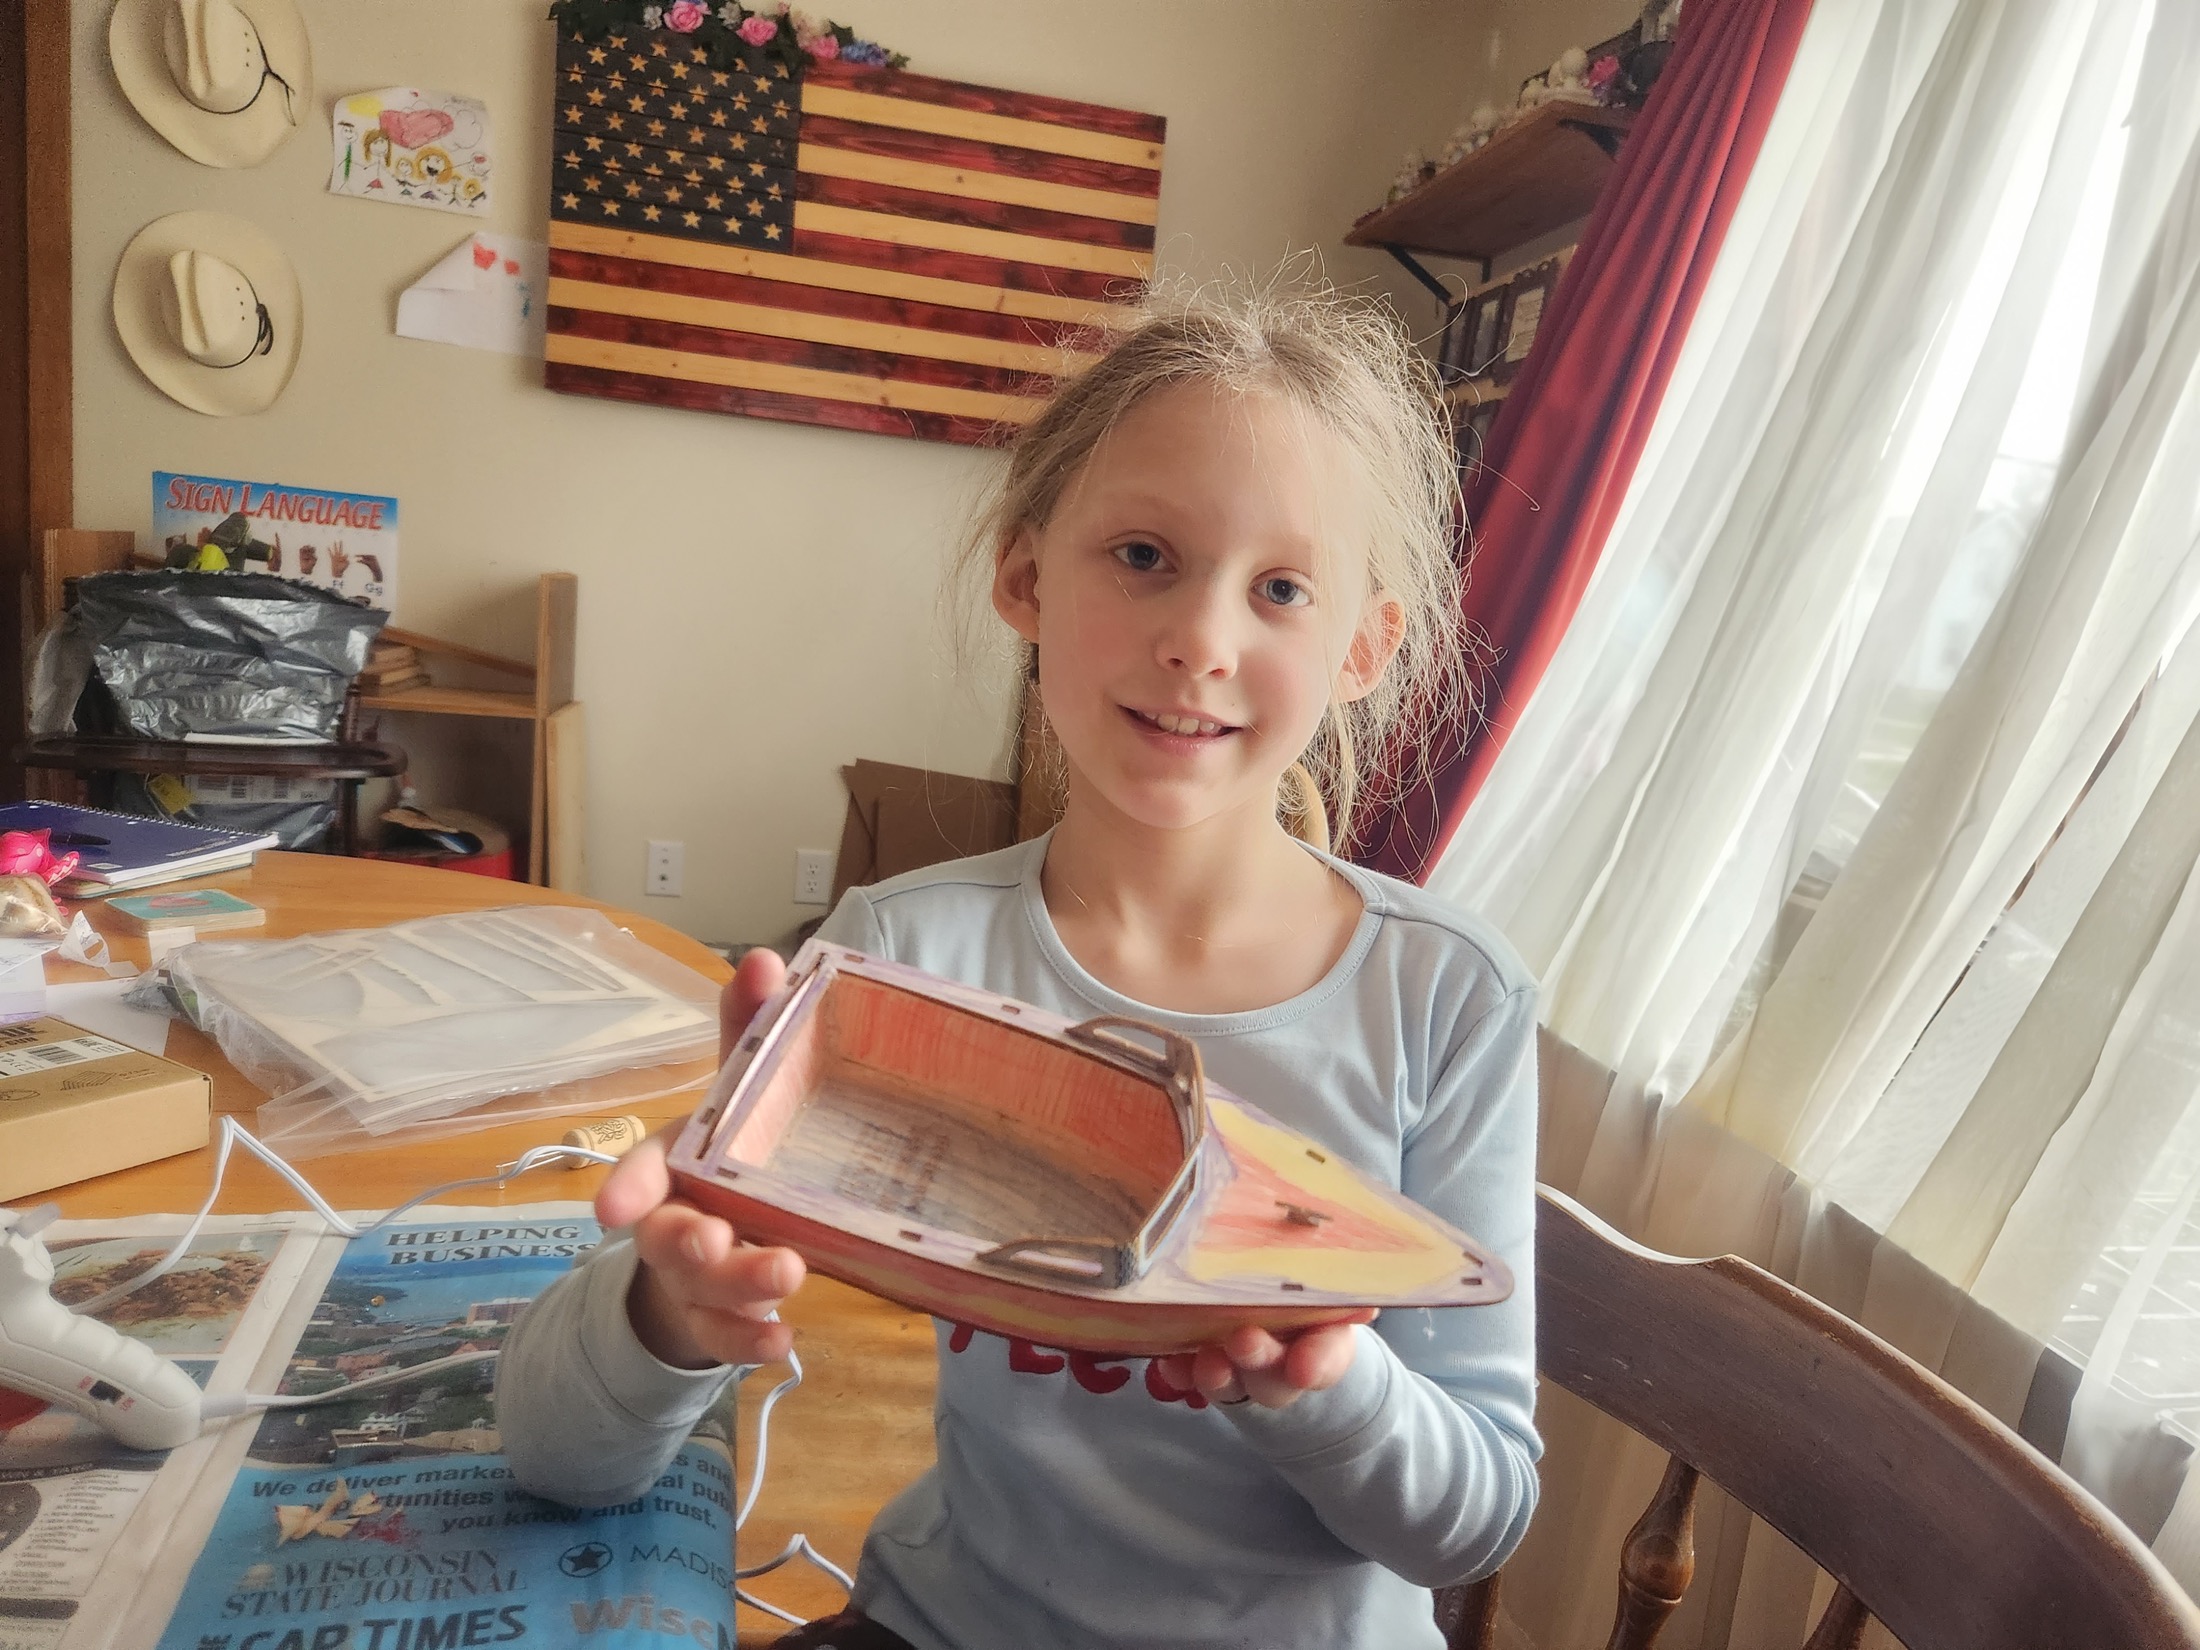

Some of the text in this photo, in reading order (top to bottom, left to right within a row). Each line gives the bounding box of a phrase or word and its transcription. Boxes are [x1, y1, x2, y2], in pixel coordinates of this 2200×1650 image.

[165, 476, 387, 531] SIGN LANGUAGE
[386, 1226, 580, 1246] HELPING
[389, 1243, 598, 1265] BUSINESS
[253, 1480, 296, 1498] We
[441, 1514, 492, 1533] you
[593, 1498, 644, 1518] and
[654, 1496, 717, 1530] trust.
[284, 1549, 497, 1587] WISCONSIN
[220, 1568, 528, 1620] STATE JOURNAL
[362, 1604, 528, 1650] TIMES
